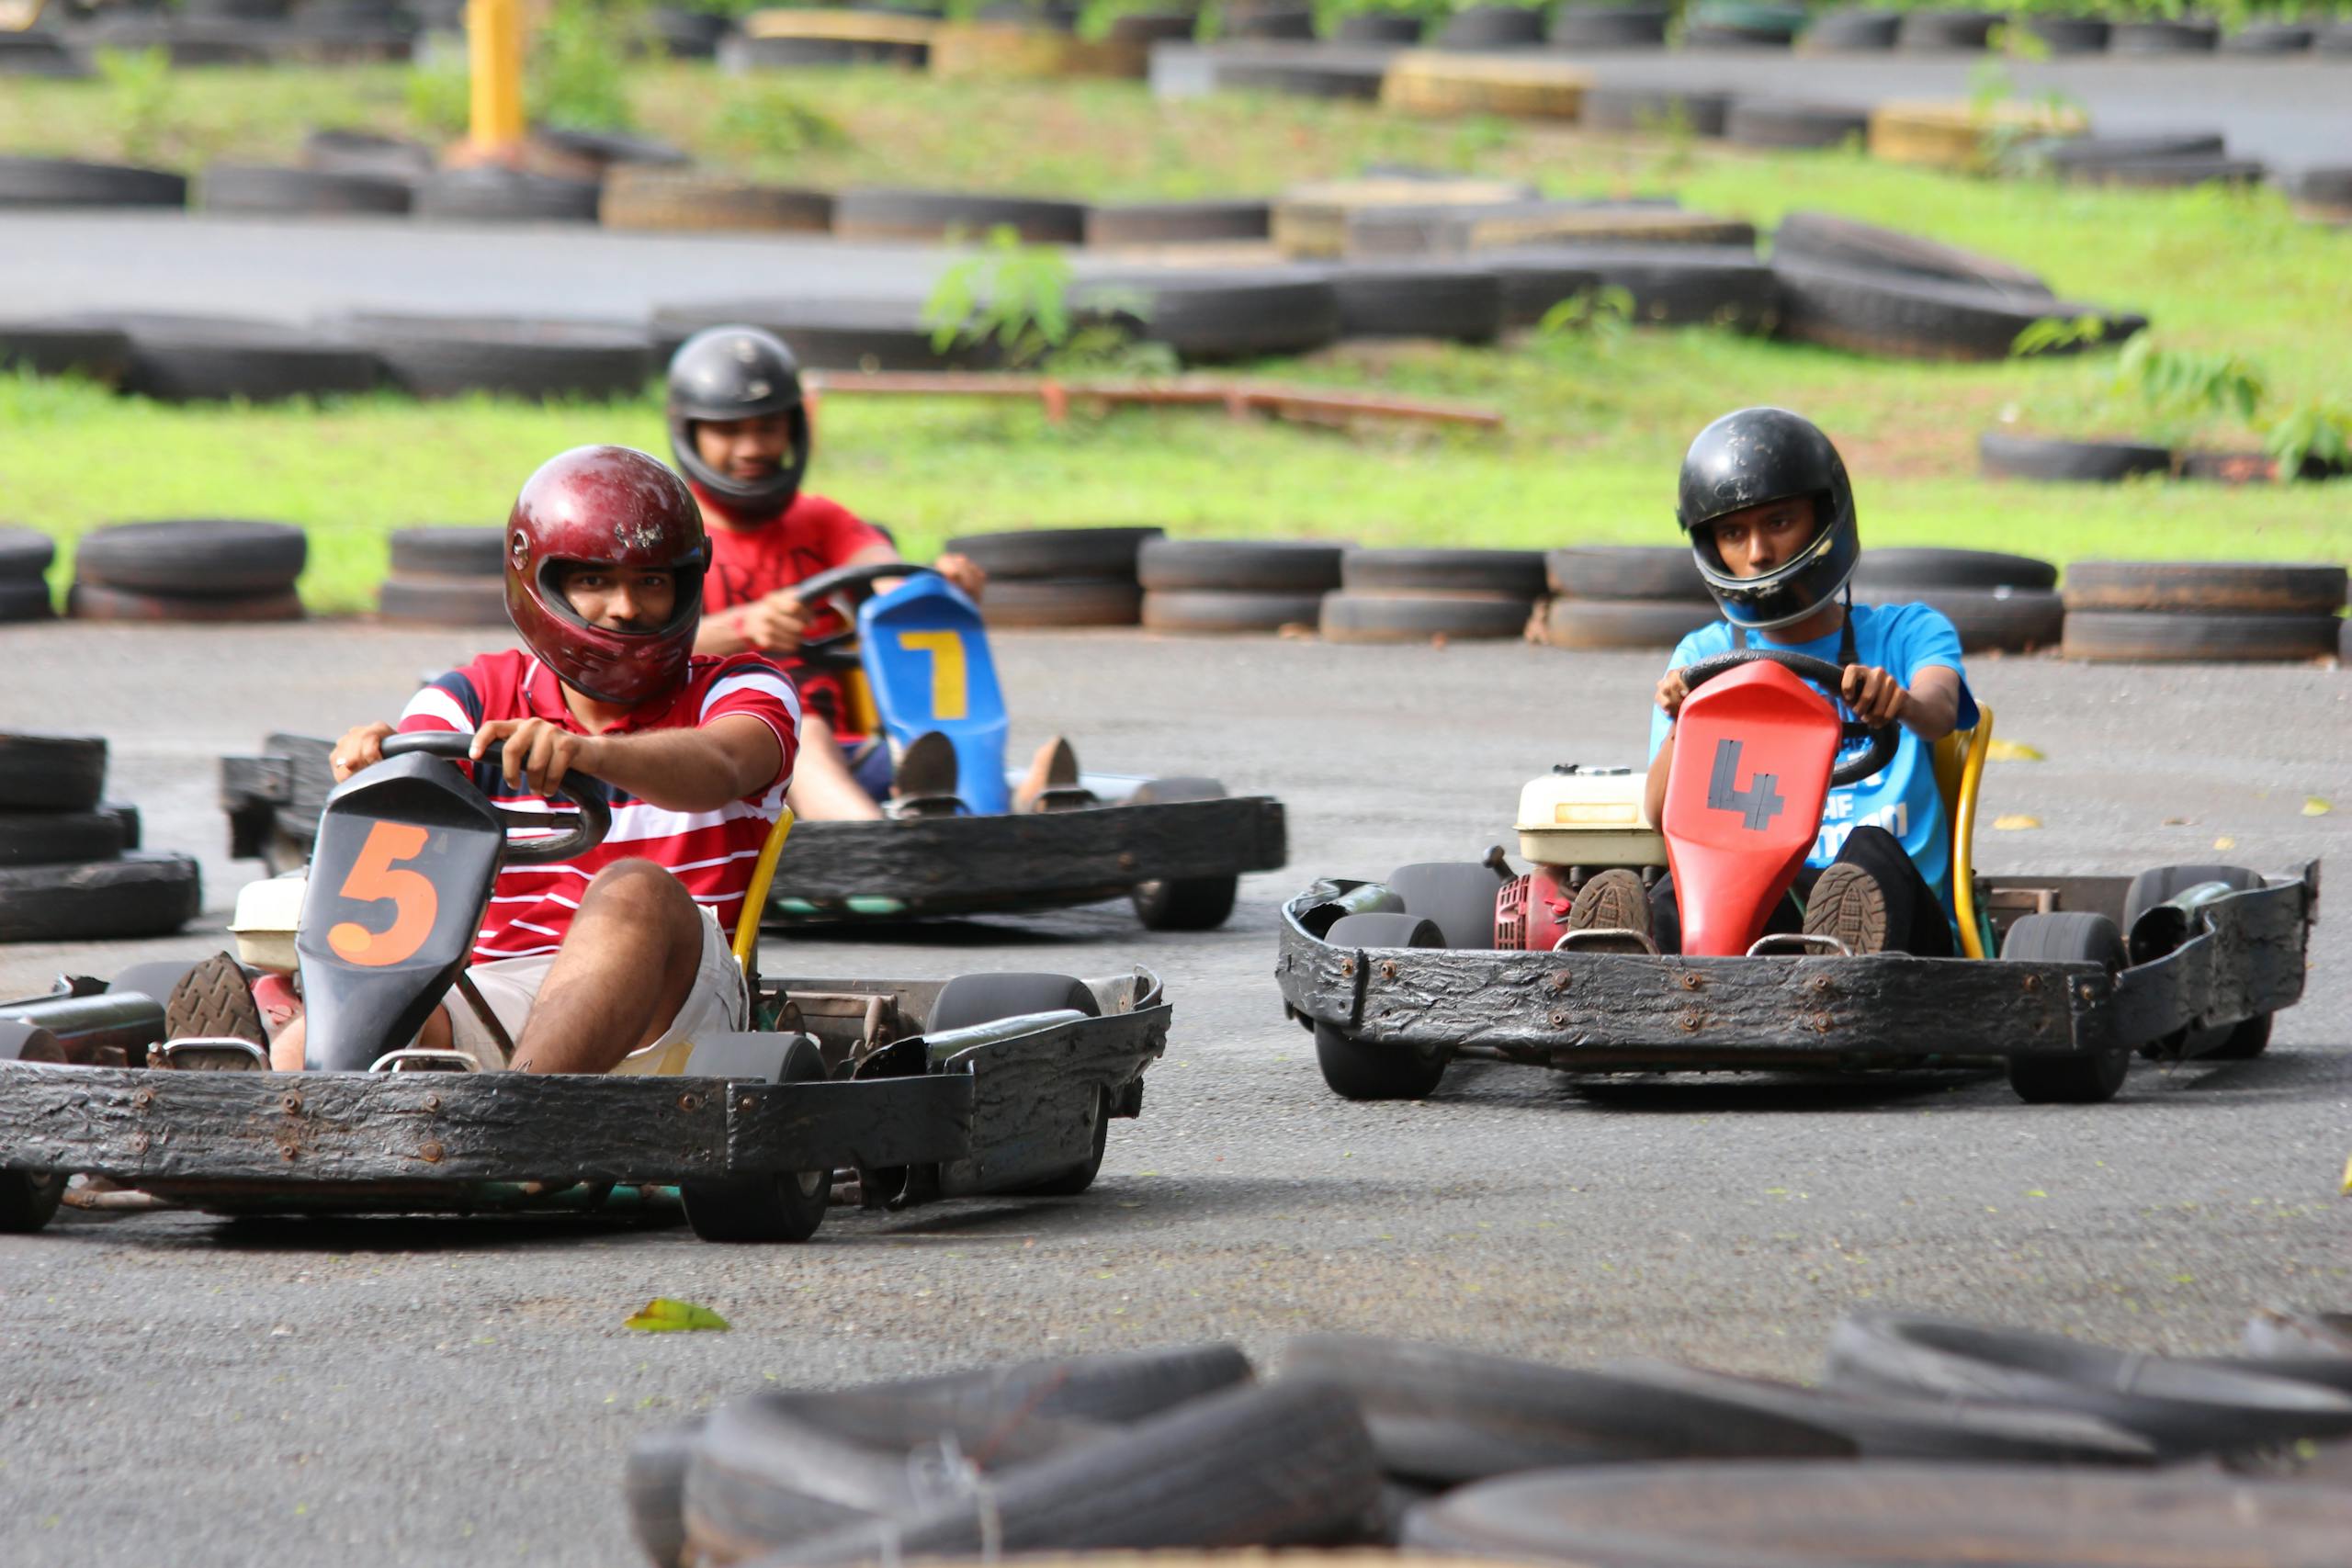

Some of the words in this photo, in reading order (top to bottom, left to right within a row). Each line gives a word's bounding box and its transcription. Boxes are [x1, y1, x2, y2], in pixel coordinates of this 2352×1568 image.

[898, 631, 968, 721] 7
[1707, 739, 1785, 831] 4
[327, 820, 438, 966] 5
